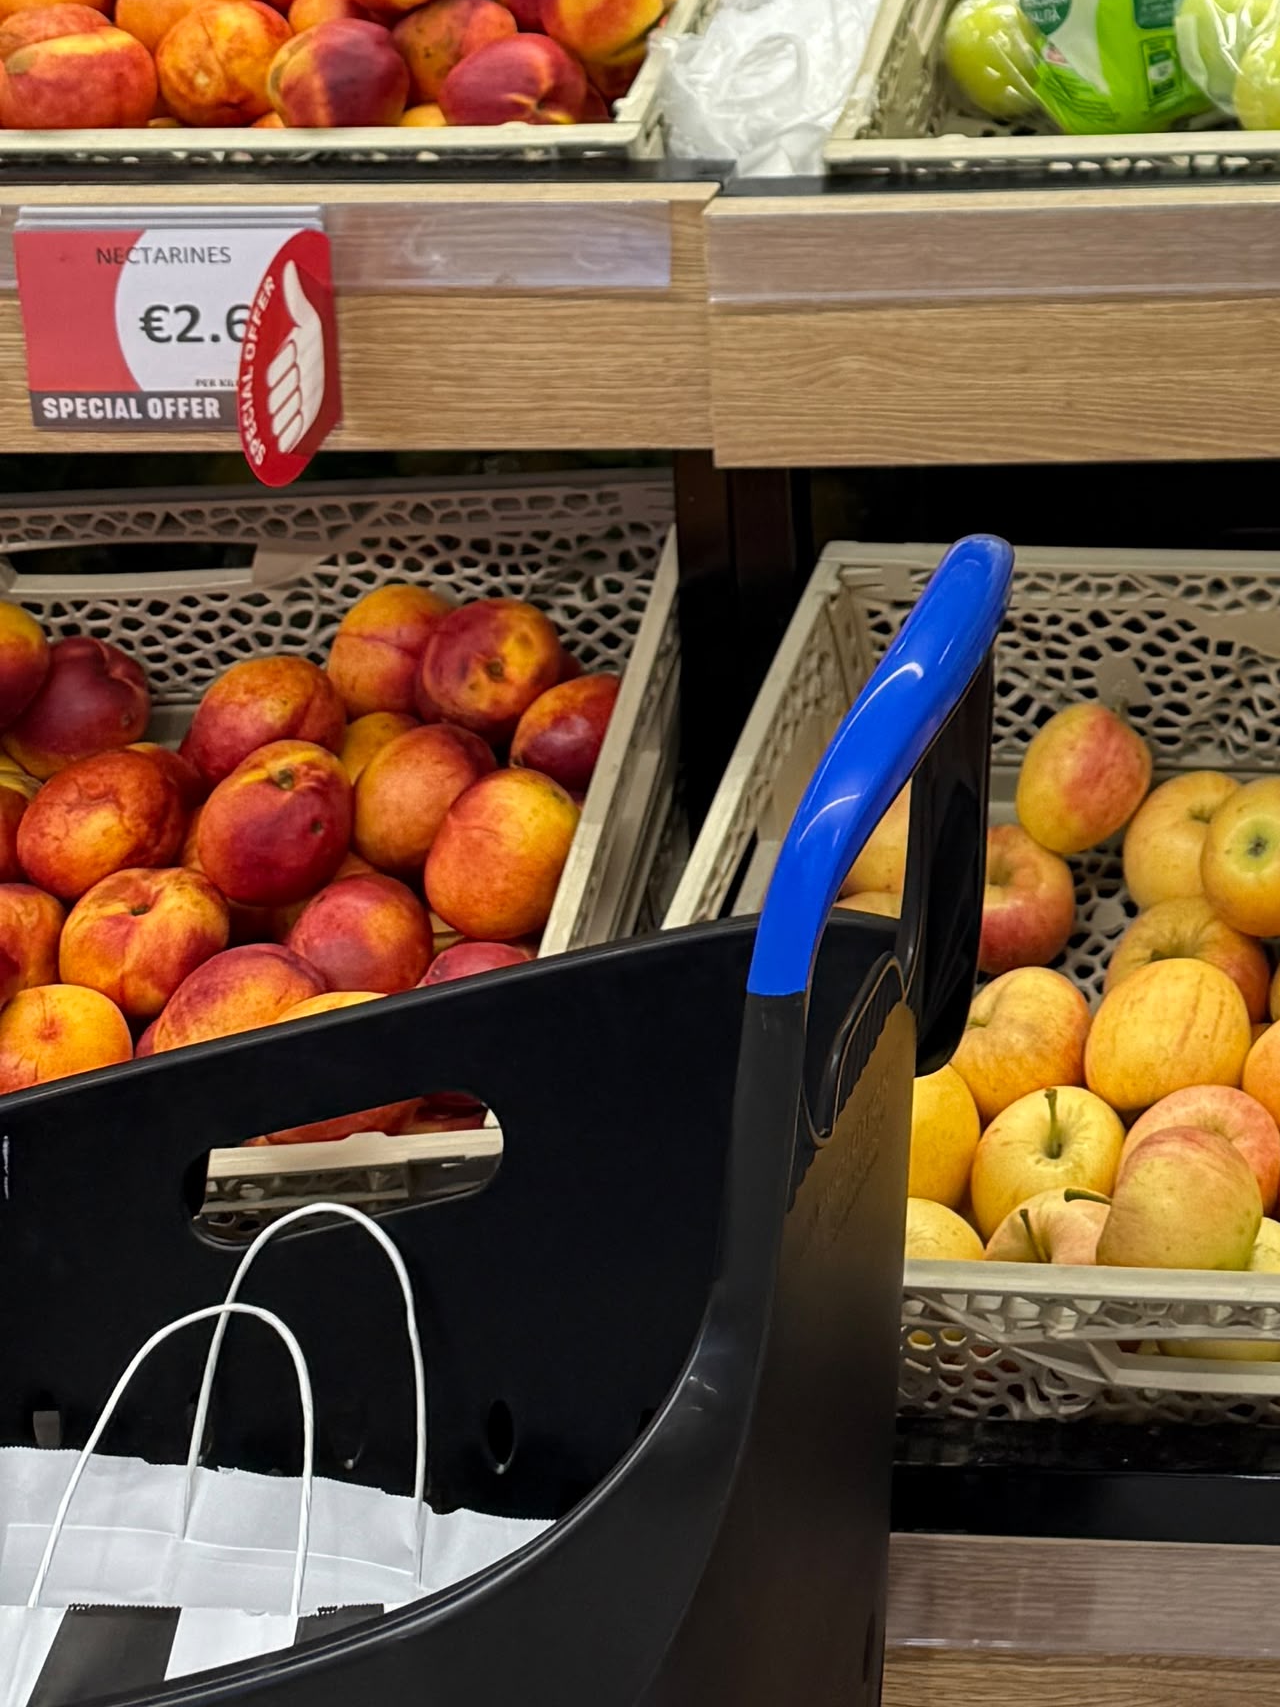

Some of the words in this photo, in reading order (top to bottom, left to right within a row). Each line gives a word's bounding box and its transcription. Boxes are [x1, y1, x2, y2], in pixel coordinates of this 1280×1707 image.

[96, 246, 231, 264] NECTARINES
[138, 303, 252, 343] €2.6
[243, 276, 275, 361] OFFER
[41, 396, 143, 419] SPECIAL
[146, 396, 221, 419] OFFER
[241, 365, 267, 467] SPECIAL
